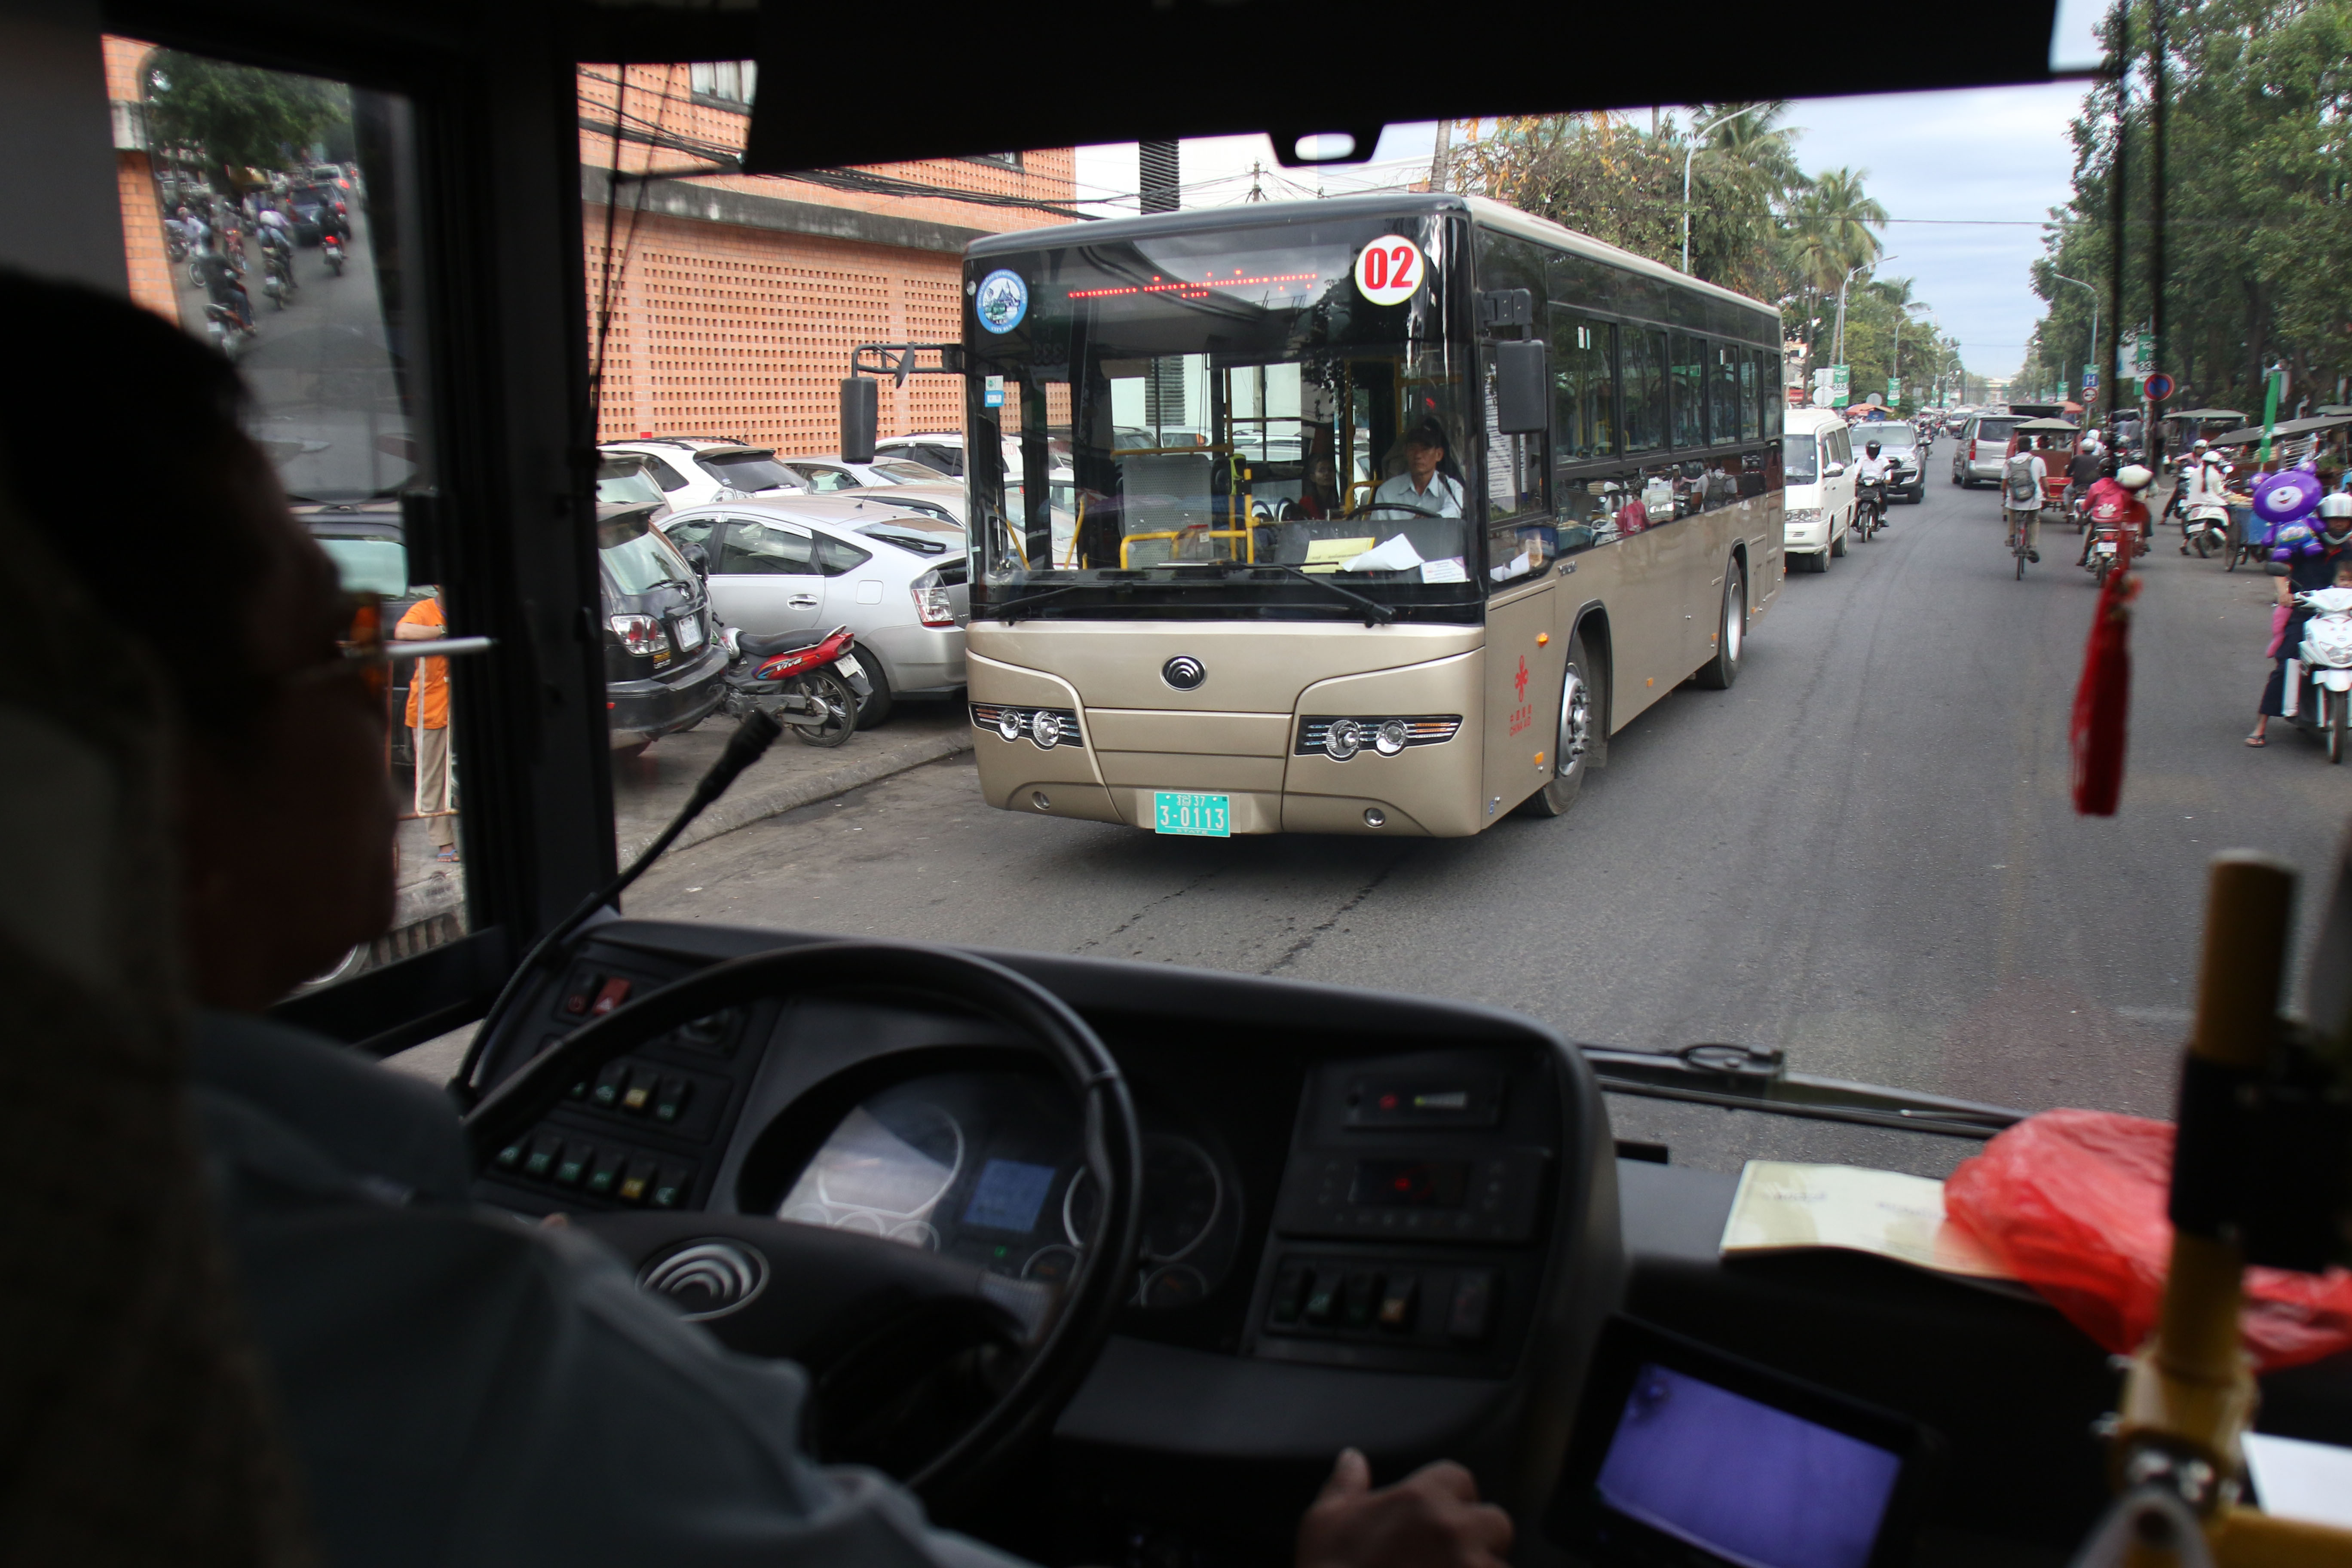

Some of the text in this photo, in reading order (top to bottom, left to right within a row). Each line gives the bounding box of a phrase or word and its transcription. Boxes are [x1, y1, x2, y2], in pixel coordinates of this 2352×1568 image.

[1365, 246, 1414, 290] 02
[2086, 375, 2096, 386] H
[776, 657, 802, 671] Viva
[1194, 796, 1205, 807] 37
[1160, 805, 1224, 829] 3-0113
